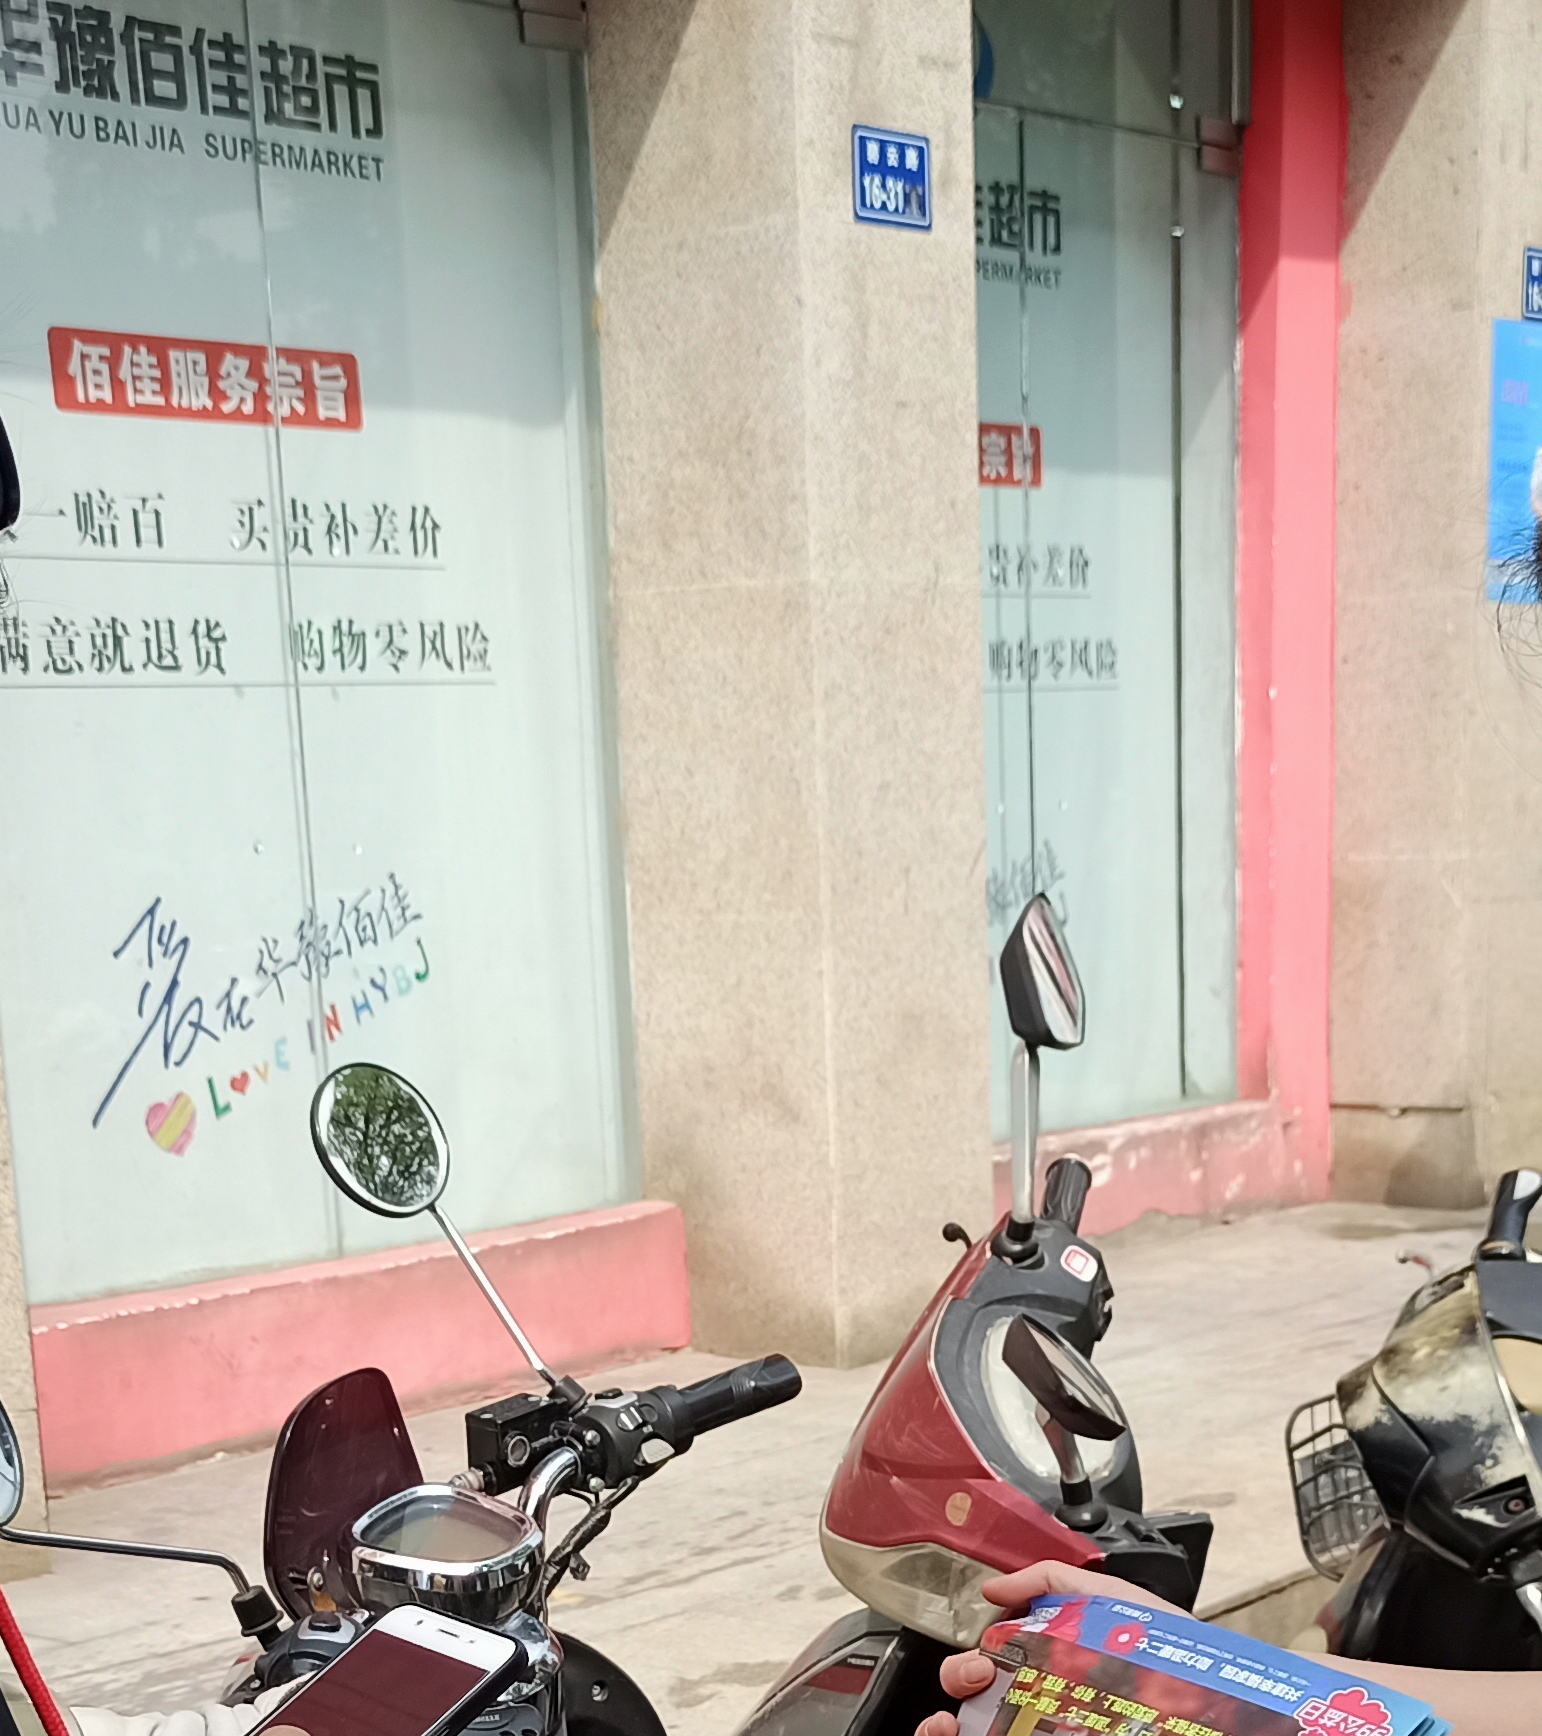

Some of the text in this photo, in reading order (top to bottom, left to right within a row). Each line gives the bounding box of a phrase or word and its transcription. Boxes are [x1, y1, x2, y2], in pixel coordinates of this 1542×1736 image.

[204, 133, 385, 183] SUPERMARKET
[67, 338, 348, 424] 佰佳服务宗旨
[230, 497, 442, 559] 买贵补差价
[291, 616, 494, 675] 购物零风险
